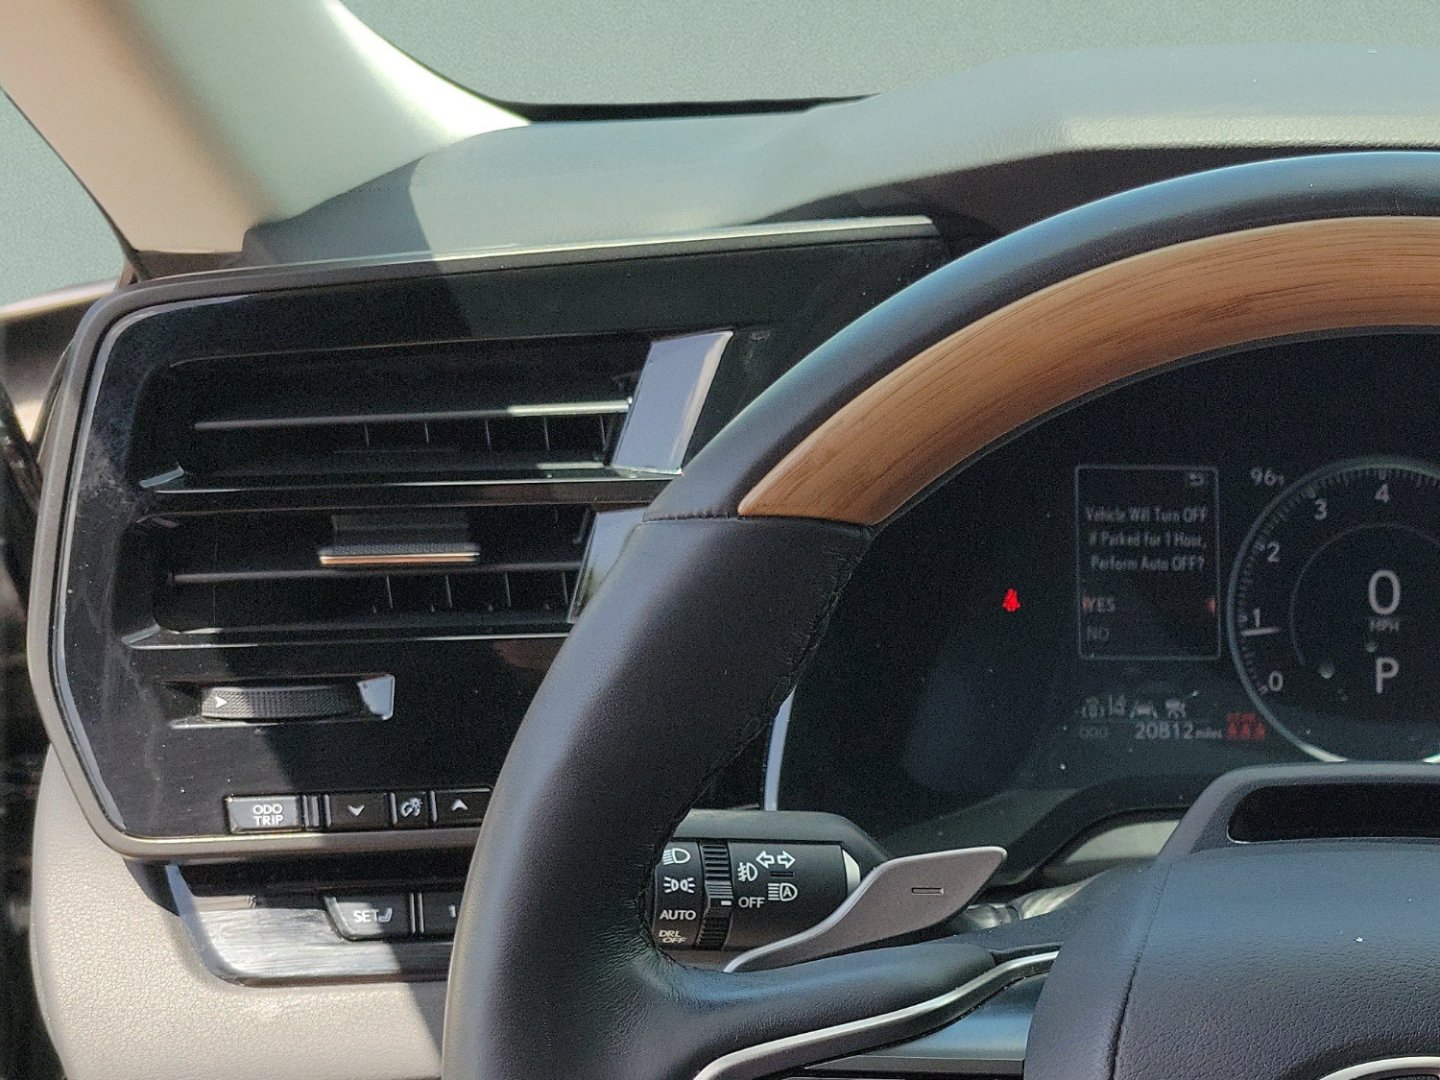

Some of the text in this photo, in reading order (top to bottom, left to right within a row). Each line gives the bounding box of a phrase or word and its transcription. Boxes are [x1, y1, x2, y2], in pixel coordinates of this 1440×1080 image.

[1374, 485, 1390, 503] 4
[1314, 501, 1328, 520] 3
[1267, 543, 1281, 562] 2
[1252, 607, 1261, 628] 1
[1267, 671, 1284, 692] 0
[1375, 656, 1400, 694] P
[1135, 721, 1194, 739] 20812
[253, 803, 283, 815] ODO
[253, 814, 284, 826] TRIP
[738, 896, 766, 909] OFF
[353, 909, 380, 923] SET
[660, 909, 697, 920] AUTO
[659, 930, 682, 938] DRL
